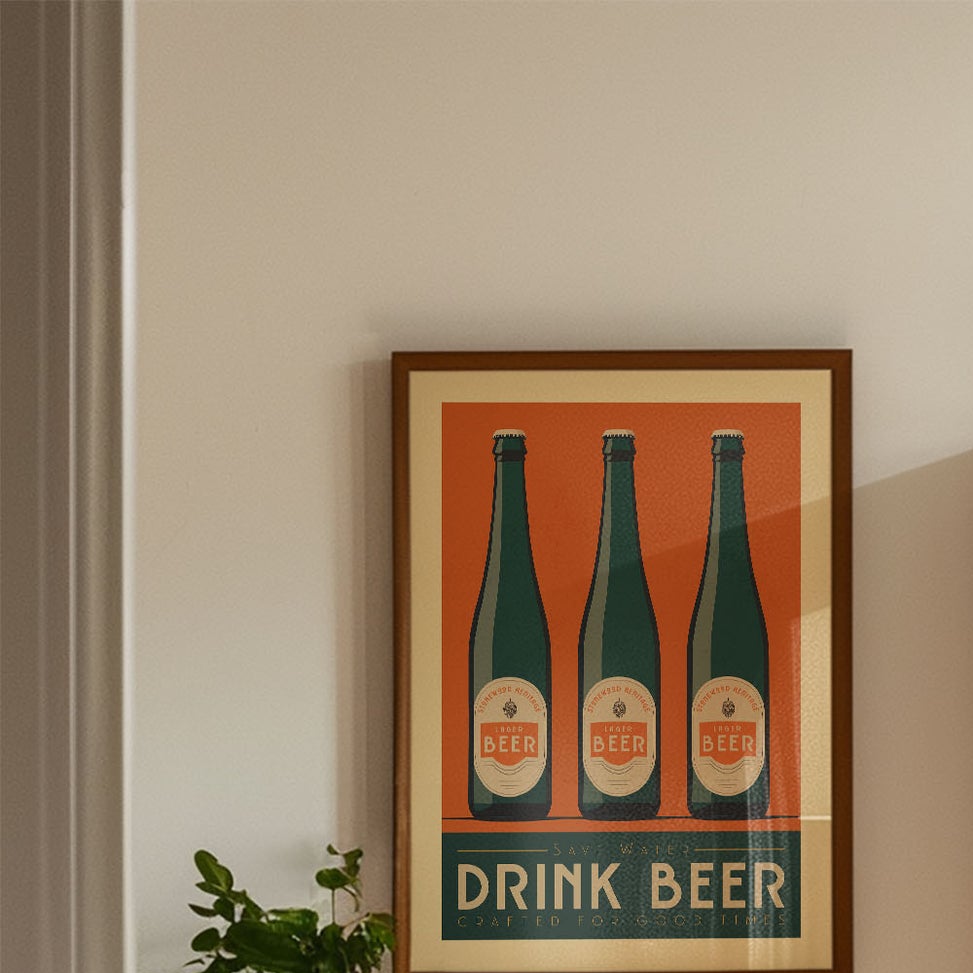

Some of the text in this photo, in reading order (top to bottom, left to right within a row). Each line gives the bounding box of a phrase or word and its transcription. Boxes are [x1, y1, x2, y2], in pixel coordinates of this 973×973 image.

[483, 735, 536, 753] BEER
[593, 734, 645, 753] BEER
[702, 734, 754, 753] BEER
[457, 862, 785, 910] DRINK BEER
